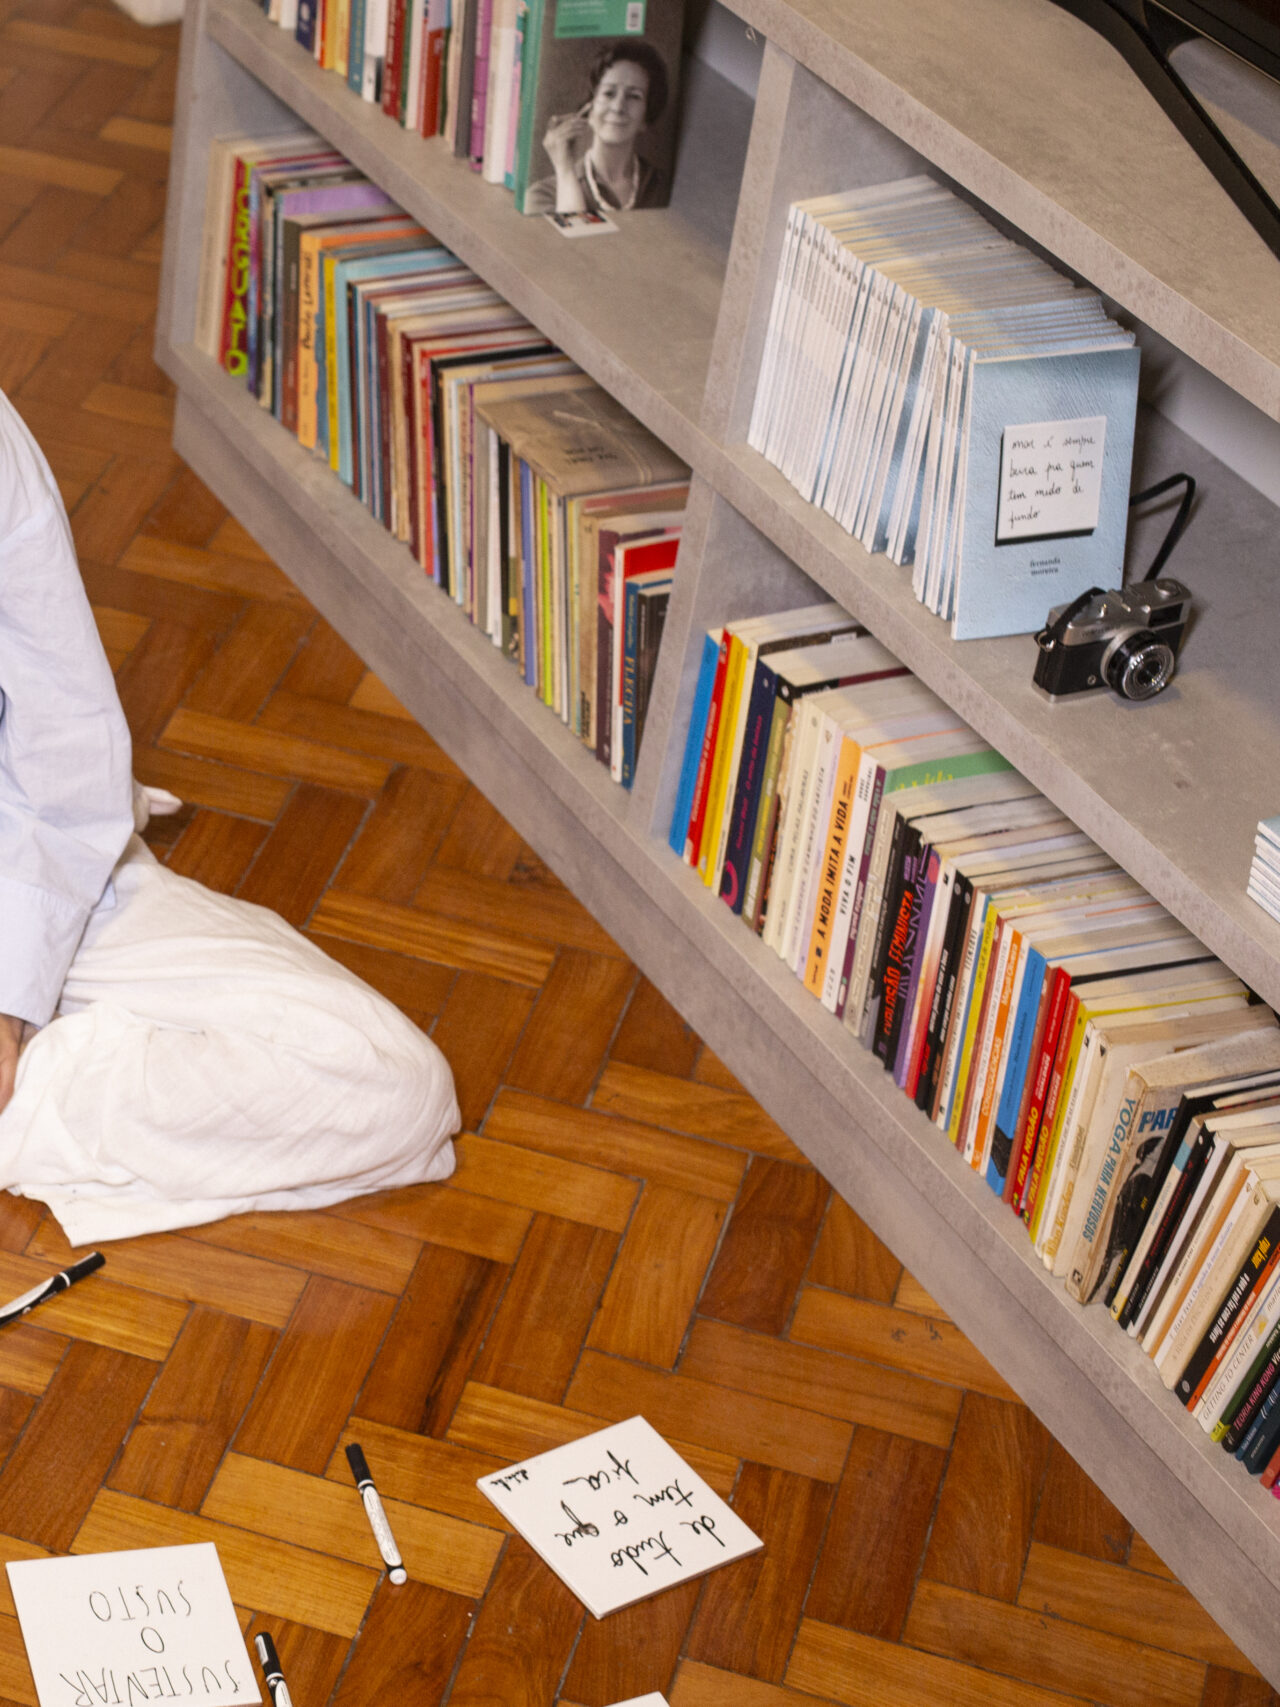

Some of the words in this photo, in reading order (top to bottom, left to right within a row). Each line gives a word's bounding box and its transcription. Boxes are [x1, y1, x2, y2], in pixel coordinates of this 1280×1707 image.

[833, 799, 849, 831] VIDA
[831, 834, 842, 845] A
[824, 847, 840, 886] IMITA
[845, 852, 857, 875] FIM
[843, 878, 852, 887] O
[817, 888, 833, 926] MODA
[838, 889, 850, 915] VIVA
[815, 928, 826, 939] A
[886, 888, 915, 966] FEMINISTA
[1035, 1053, 1052, 1100] IGUALDADE
[1022, 1104, 1040, 1153] NEGÃO
[1107, 1095, 1137, 1155] YOGA
[1033, 1123, 1050, 1172] NEGÃO
[1016, 1153, 1029, 1187] FALA
[1098, 1152, 1118, 1186] PARA
[1027, 1172, 1040, 1204] FALA
[1053, 1178, 1075, 1227] Kundera
[1080, 1183, 1109, 1243] NERVOSOS
[1236, 1275, 1249, 1290] que
[1218, 1306, 1233, 1322] com
[1206, 1325, 1224, 1344] flores
[1200, 1381, 1227, 1421] GETTING
[1222, 1367, 1235, 1382] TO
[1229, 1333, 1255, 1370] CENTER
[1231, 1402, 1253, 1431] TEORIA
[1246, 1384, 1264, 1406] KING
[1256, 1360, 1277, 1388] KONG
[633, 1479, 694, 1507] tem
[554, 1500, 600, 1547] que
[613, 1509, 629, 1526] o
[679, 1514, 726, 1548] de
[610, 1531, 683, 1577] tudo
[89, 1579, 192, 1622] SUSTO
[140, 1626, 165, 1653] O
[59, 1659, 242, 1707] SUSTENTAR
